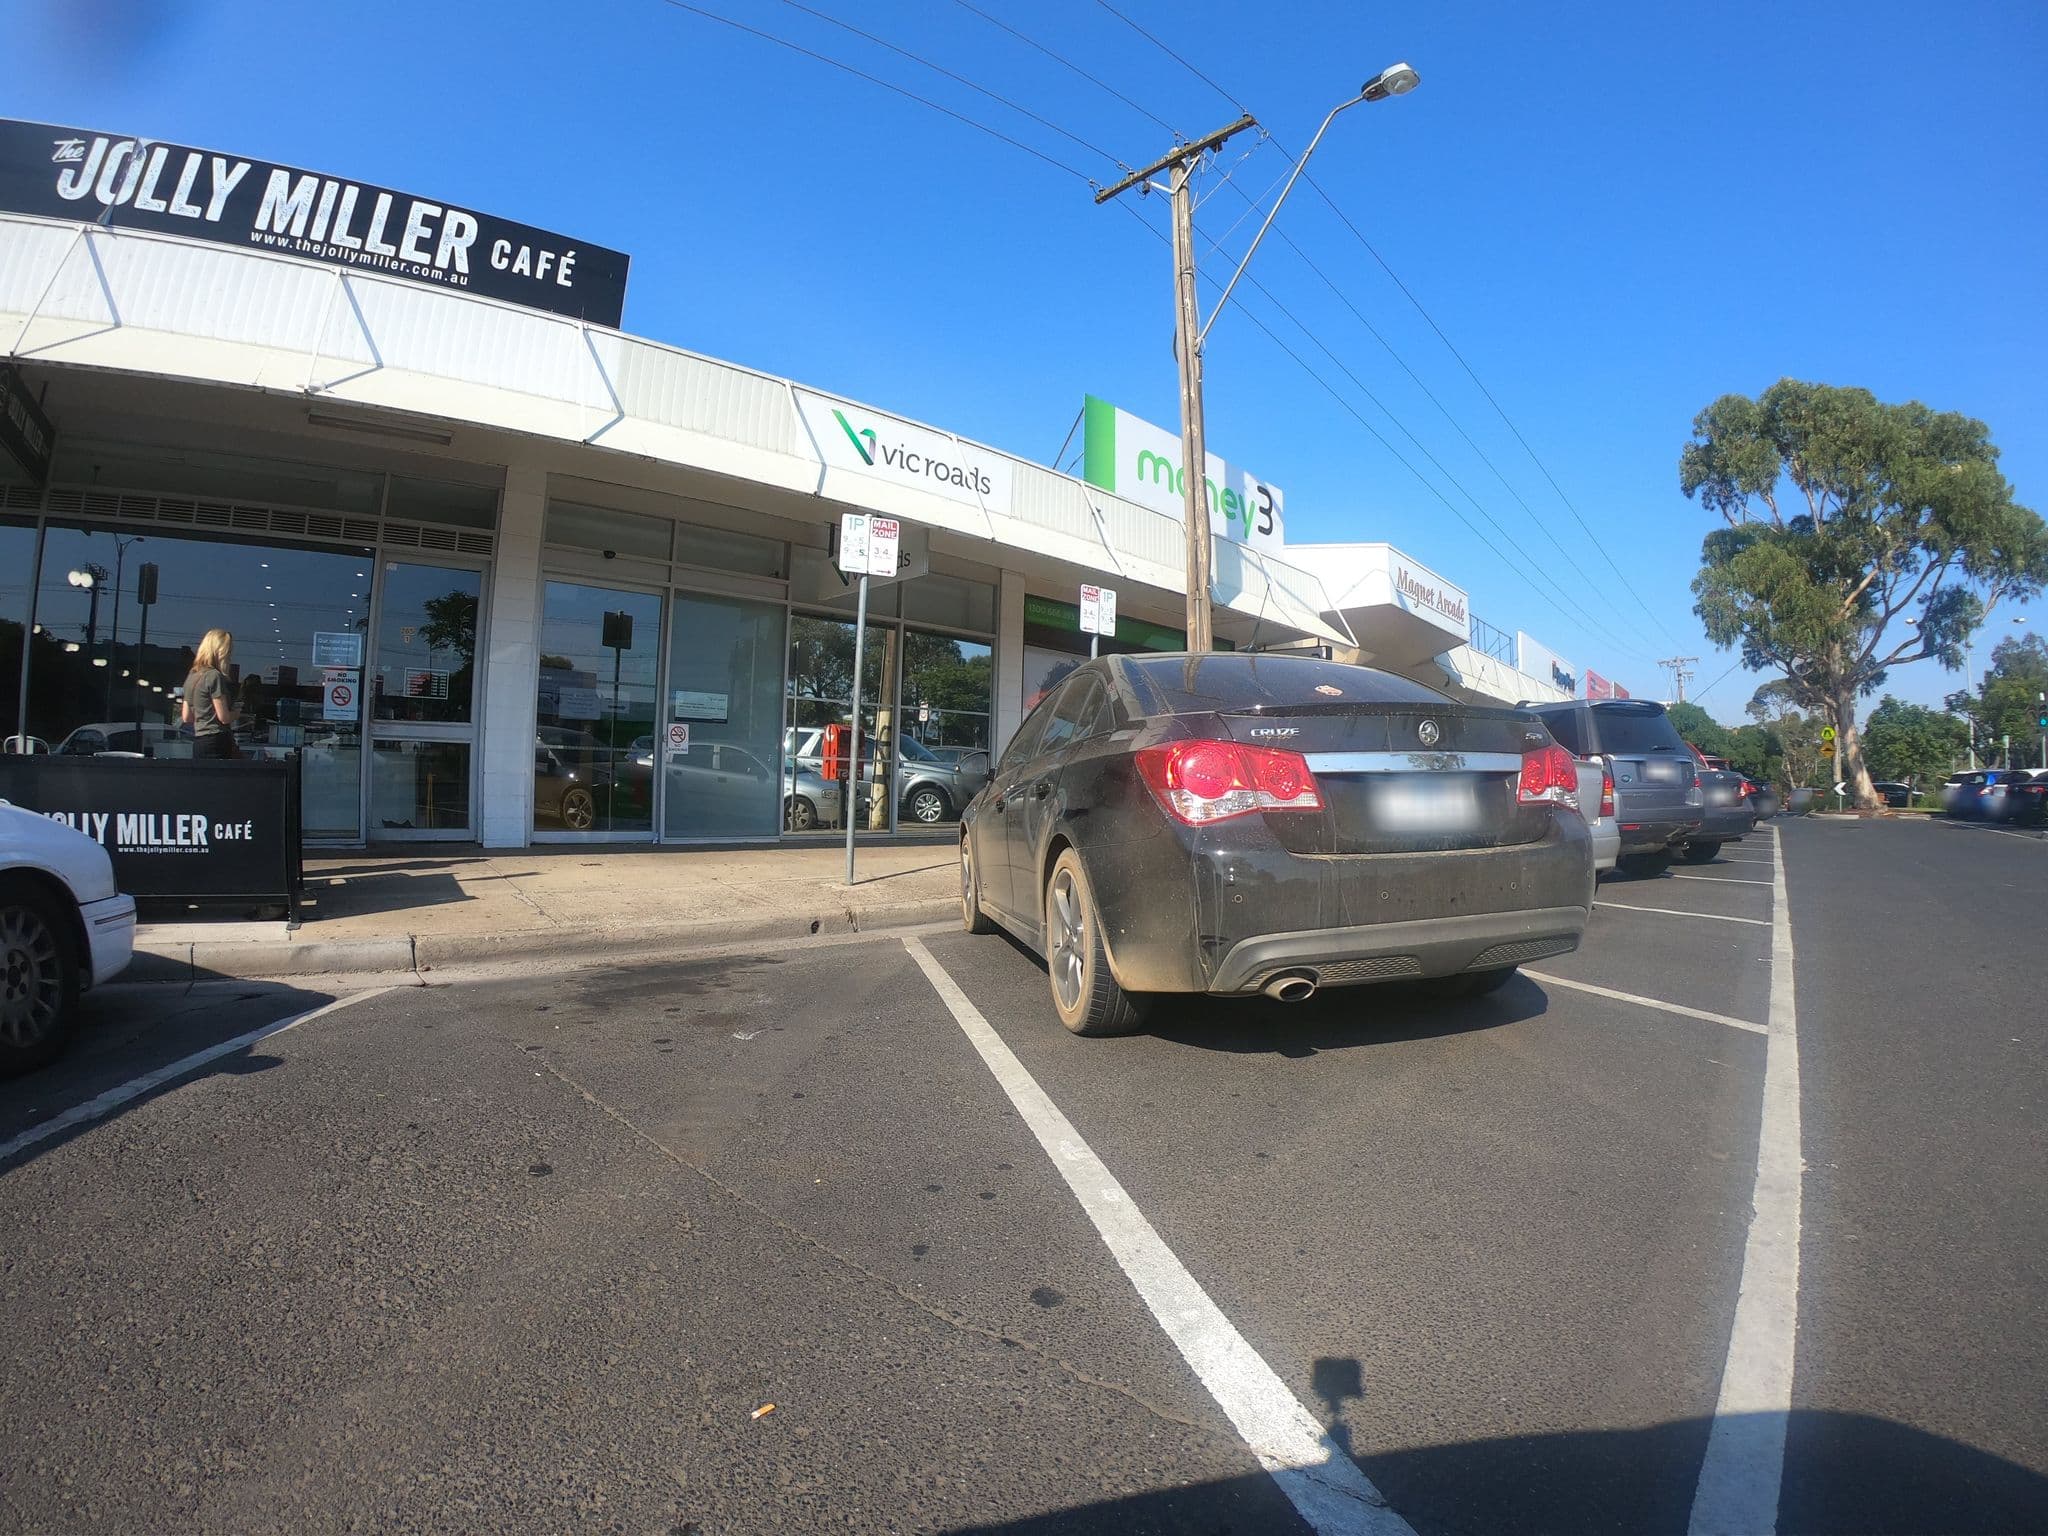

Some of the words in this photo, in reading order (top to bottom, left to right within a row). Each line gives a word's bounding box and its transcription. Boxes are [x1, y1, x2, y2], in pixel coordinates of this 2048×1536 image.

[52, 138, 86, 162] The
[57, 137, 252, 222] JOLLY
[254, 168, 478, 274] MILLER
[490, 239, 577, 288] CAFÉ
[250, 231, 469, 286] www.thejollymiller.com.au
[849, 517, 865, 531] 1P
[872, 529, 898, 540] ZONE
[873, 519, 898, 531] MAIL
[1397, 567, 1434, 608] Magnet
[1436, 590, 1465, 622] Arcade
[1250, 727, 1300, 737] CRUZE
[117, 813, 208, 846] MILLER
[214, 820, 253, 840] CAFÉ
